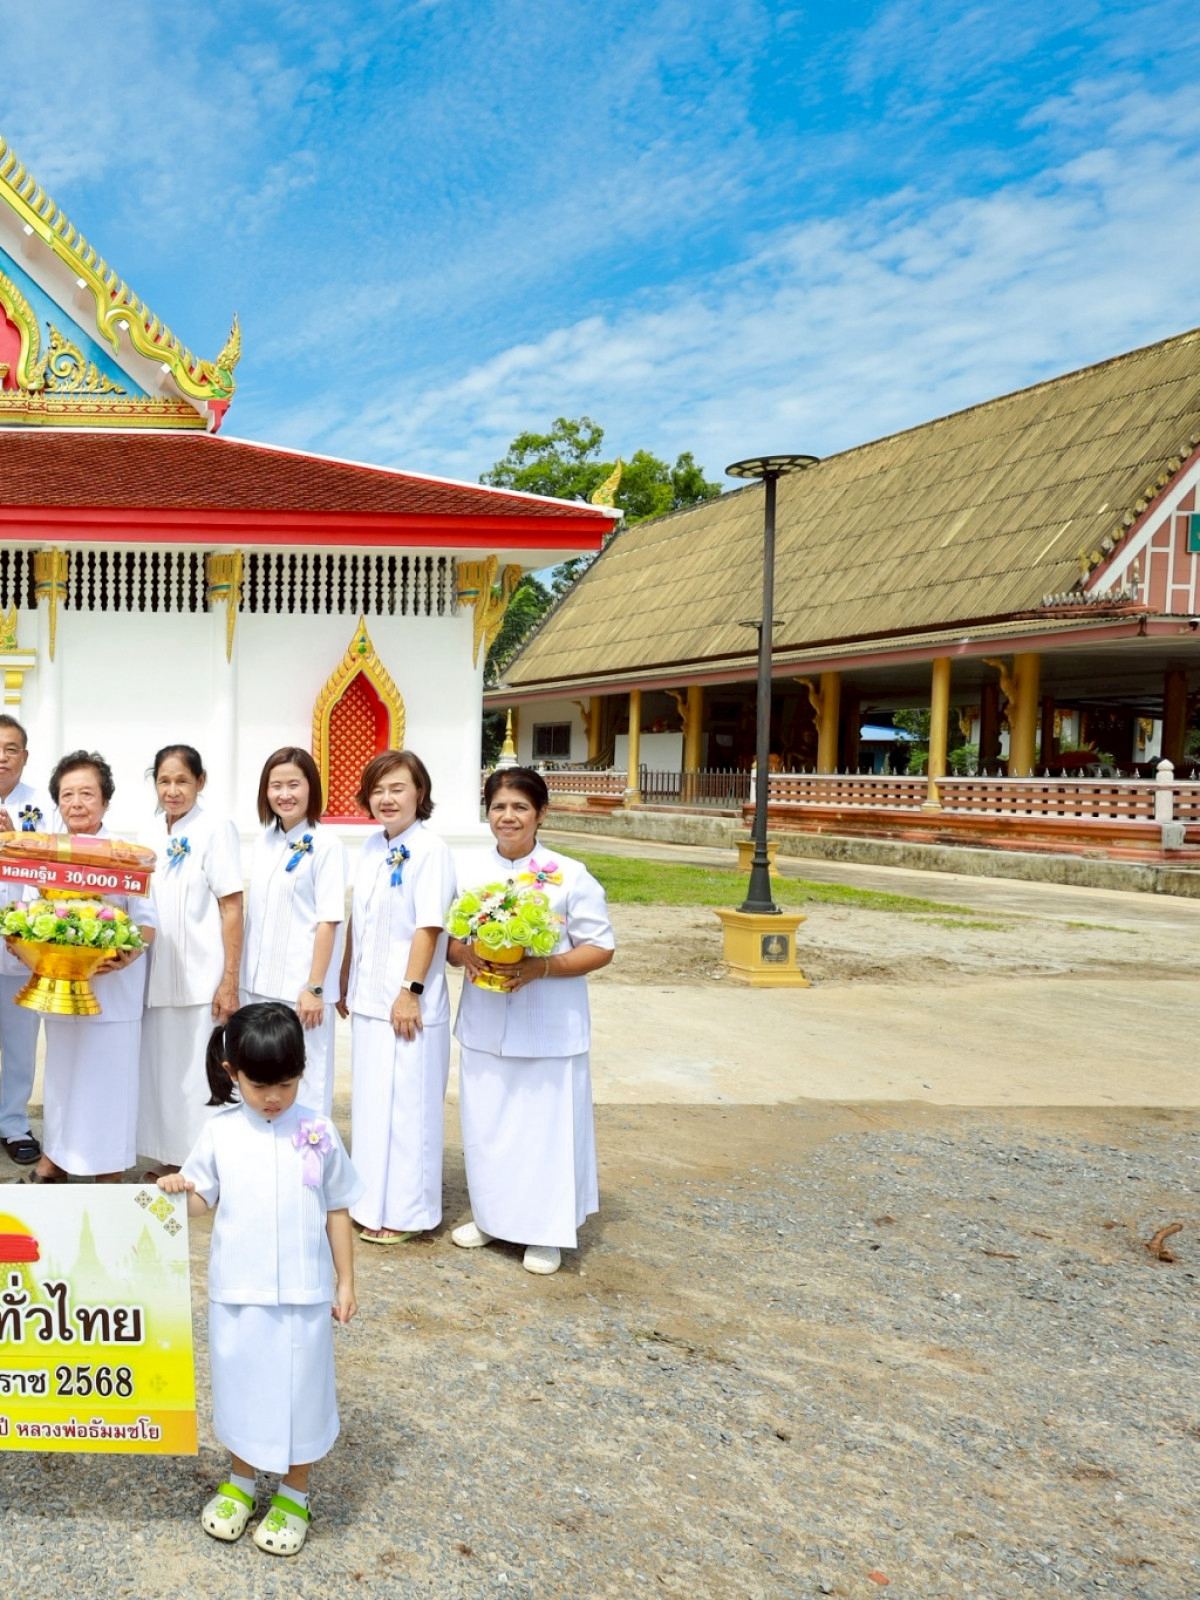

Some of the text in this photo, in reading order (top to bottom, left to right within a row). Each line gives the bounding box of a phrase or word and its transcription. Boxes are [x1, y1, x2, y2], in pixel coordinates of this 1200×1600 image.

[64, 870, 117, 888] 30,000
[121, 875, 141, 891] วัด
[55, 1367, 134, 1397] 2568
[16, 1418, 159, 1439] หลวงพ่อธัมมชโย
